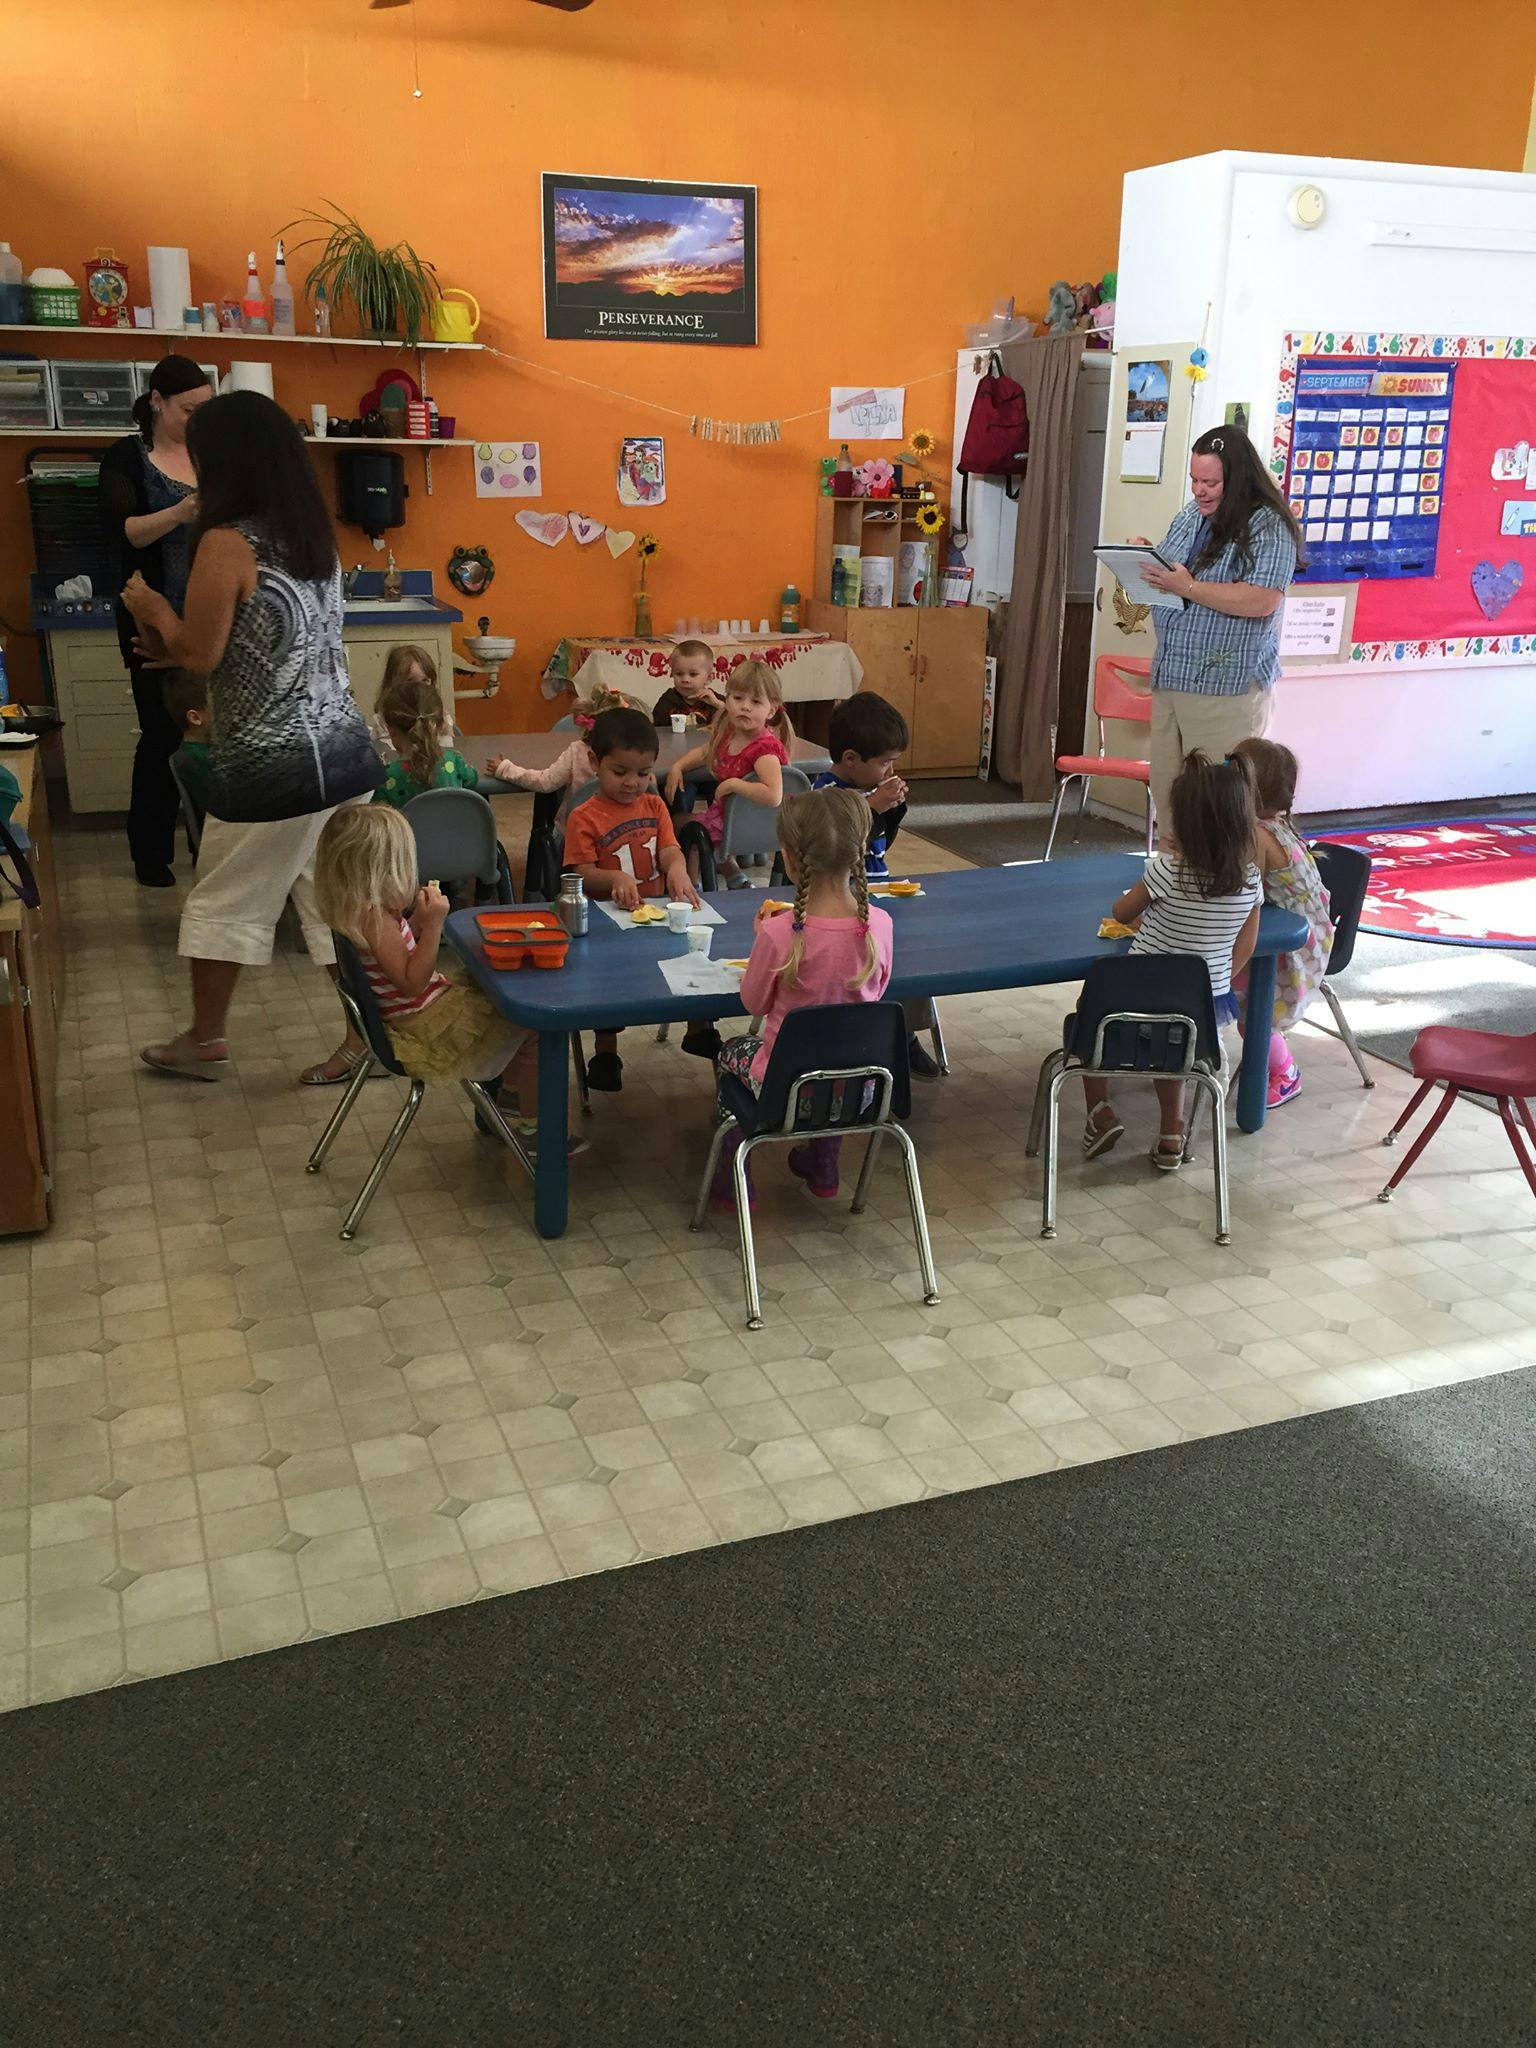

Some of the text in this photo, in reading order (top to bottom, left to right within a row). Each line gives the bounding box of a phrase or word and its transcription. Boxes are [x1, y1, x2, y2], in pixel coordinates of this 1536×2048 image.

[598, 311, 705, 329] PERSEVERANCE
[1285, 333, 1292, 352] 1
[1302, 333, 1313, 353] 2
[1324, 333, 1335, 353] 3
[1341, 335, 1354, 353] 4
[1367, 335, 1377, 354] 5
[1389, 334, 1400, 354] 6
[1409, 338, 1419, 355] 7
[1433, 338, 1443, 356] 8
[1457, 338, 1467, 356] 9
[1479, 339, 1485, 356] 1
[1494, 339, 1505, 357] 2
[1513, 338, 1524, 357] 3
[1306, 376, 1369, 388] SEPTEMBER
[1352, 643, 1362, 660] 6
[1371, 645, 1381, 661] 7
[1395, 643, 1405, 659] 8
[1418, 642, 1428, 658] 9
[1440, 641, 1446, 656] 1
[1454, 639, 1464, 656] 2
[1473, 638, 1483, 655] 3
[1489, 638, 1500, 654] 4
[1511, 636, 1520, 653] 5
[612, 836, 659, 885] 11
